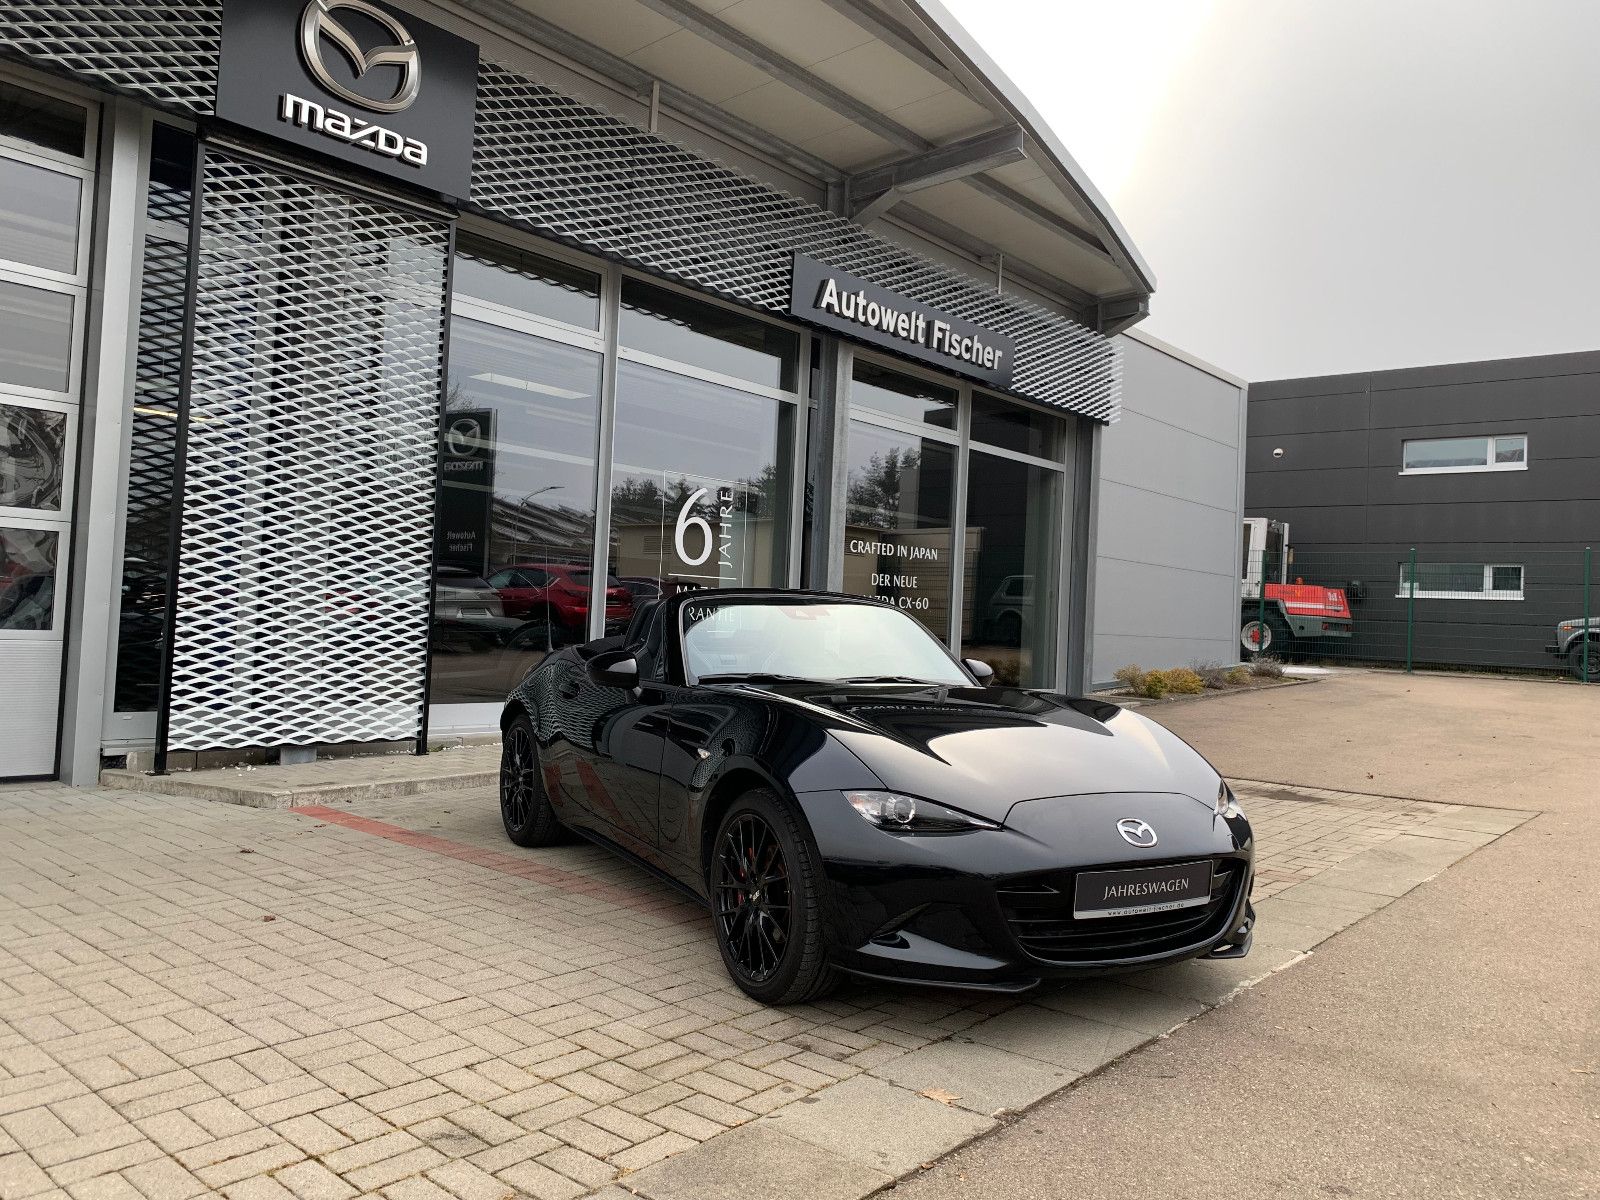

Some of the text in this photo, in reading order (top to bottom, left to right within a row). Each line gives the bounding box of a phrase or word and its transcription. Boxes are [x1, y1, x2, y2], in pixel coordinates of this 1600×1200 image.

[819, 278, 1003, 370] Autowelt Fischer
[675, 487, 713, 566] 6
[717, 490, 734, 569] JAHRE
[850, 540, 938, 561] CRAFTED IN JAPAN
[871, 573, 918, 588] DER NEUE
[688, 606, 736, 622] RANTIE
[898, 596, 929, 610] CX-60
[1102, 877, 1190, 901] JAHRESWAGEN
